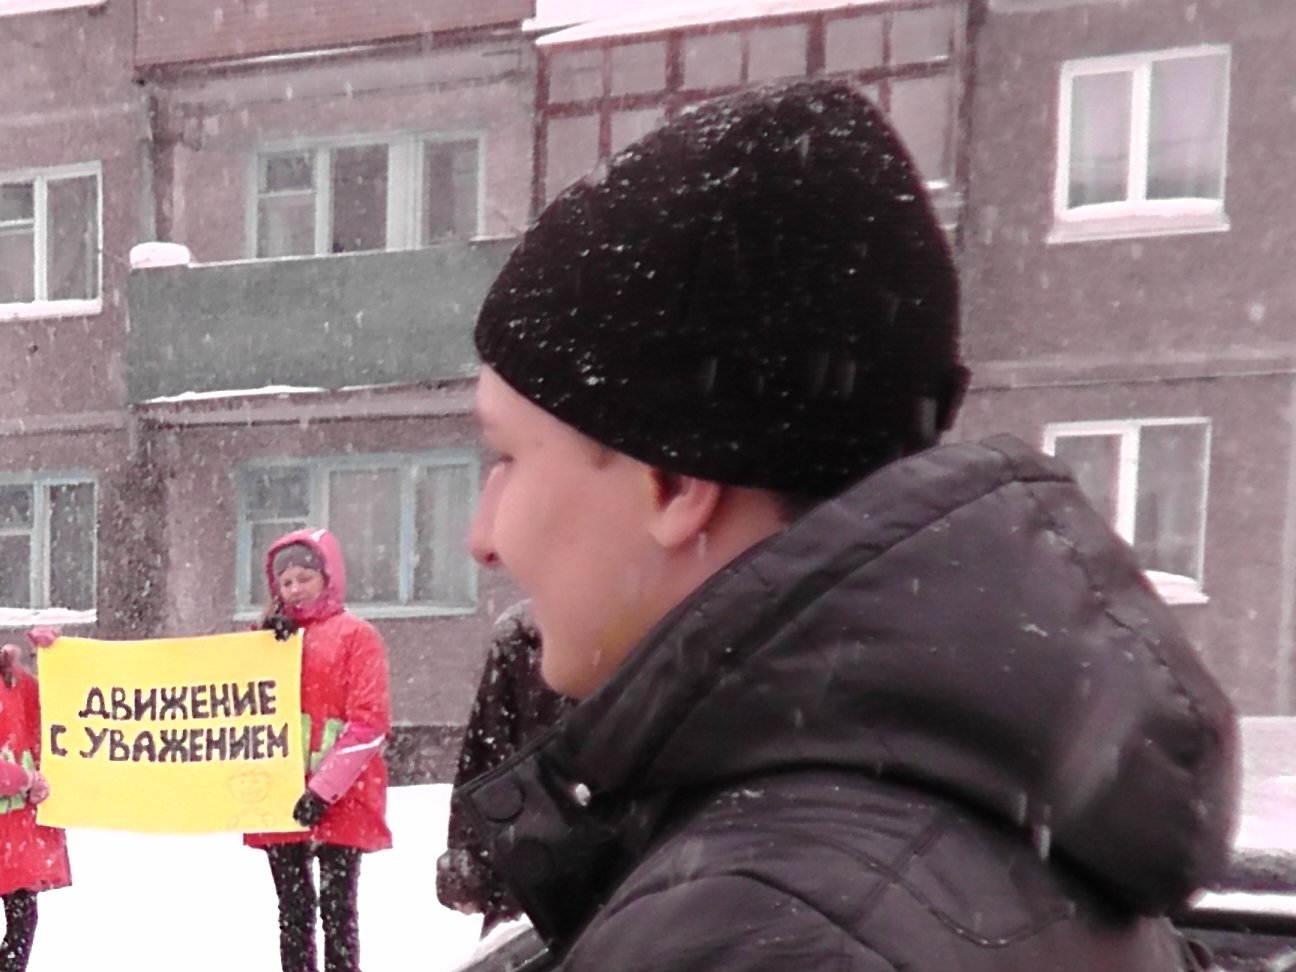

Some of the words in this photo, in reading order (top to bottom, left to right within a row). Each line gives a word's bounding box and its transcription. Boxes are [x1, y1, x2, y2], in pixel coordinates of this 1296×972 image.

[78, 680, 277, 721] ДВИЖЕНИЕ
[50, 724, 68, 757] С
[79, 723, 289, 763] УВАЖЕНИЕМ
